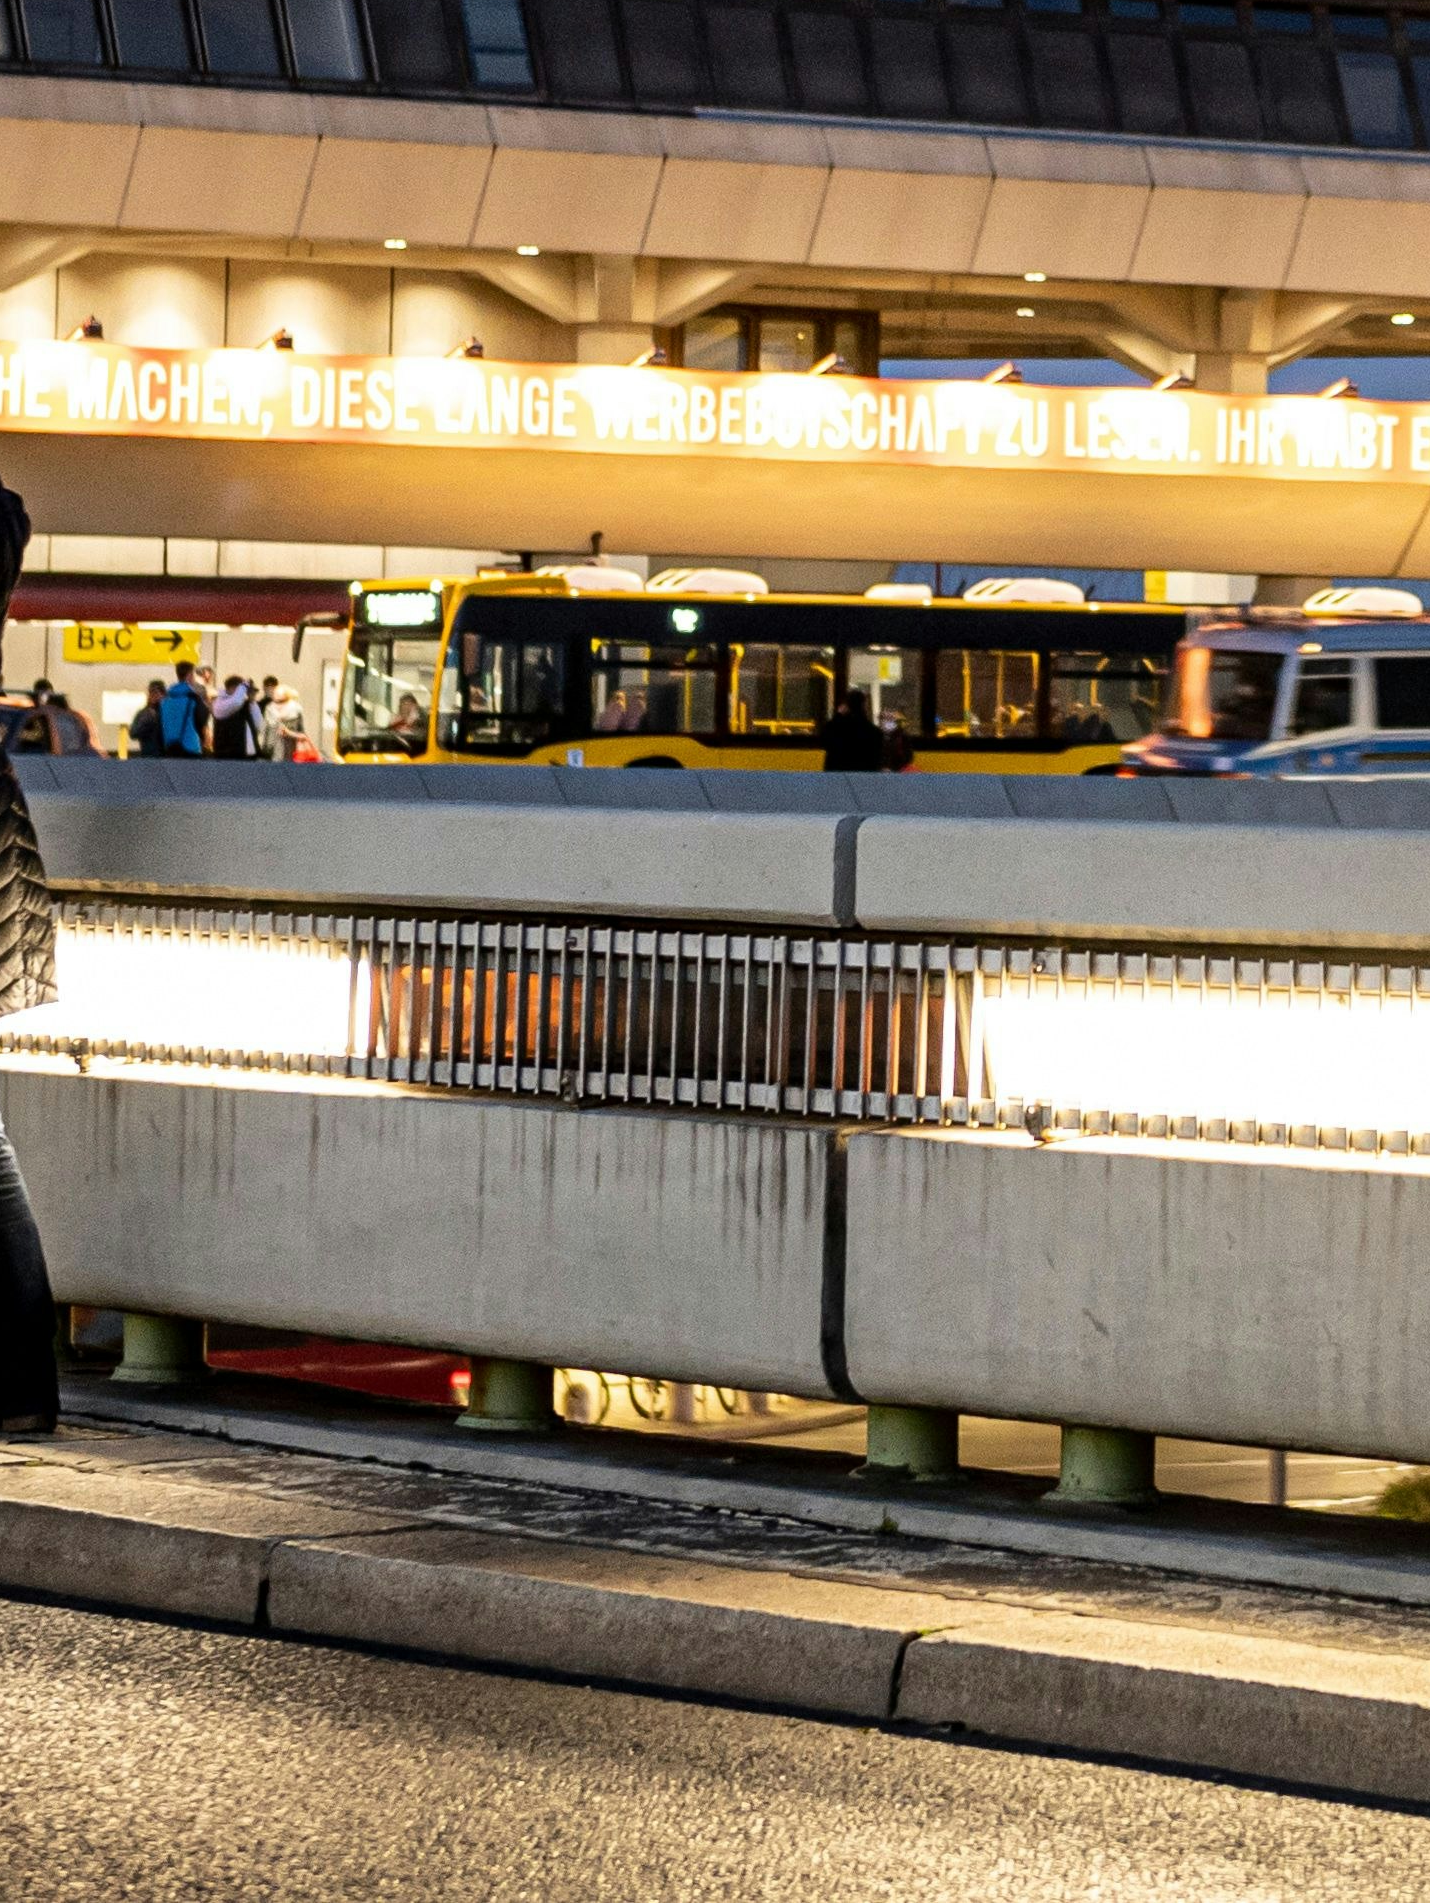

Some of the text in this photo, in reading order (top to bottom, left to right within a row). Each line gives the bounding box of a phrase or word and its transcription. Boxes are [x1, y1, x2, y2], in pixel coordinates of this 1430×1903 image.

[68, 356, 273, 435] MACHEN,
[291, 365, 420, 432] DIESE
[435, 371, 577, 436] LANGE
[995, 398, 1048, 457] ZU
[1217, 408, 1283, 466] IHR
[1295, 412, 1398, 469] HABT
[77, 625, 132, 651] B+C
